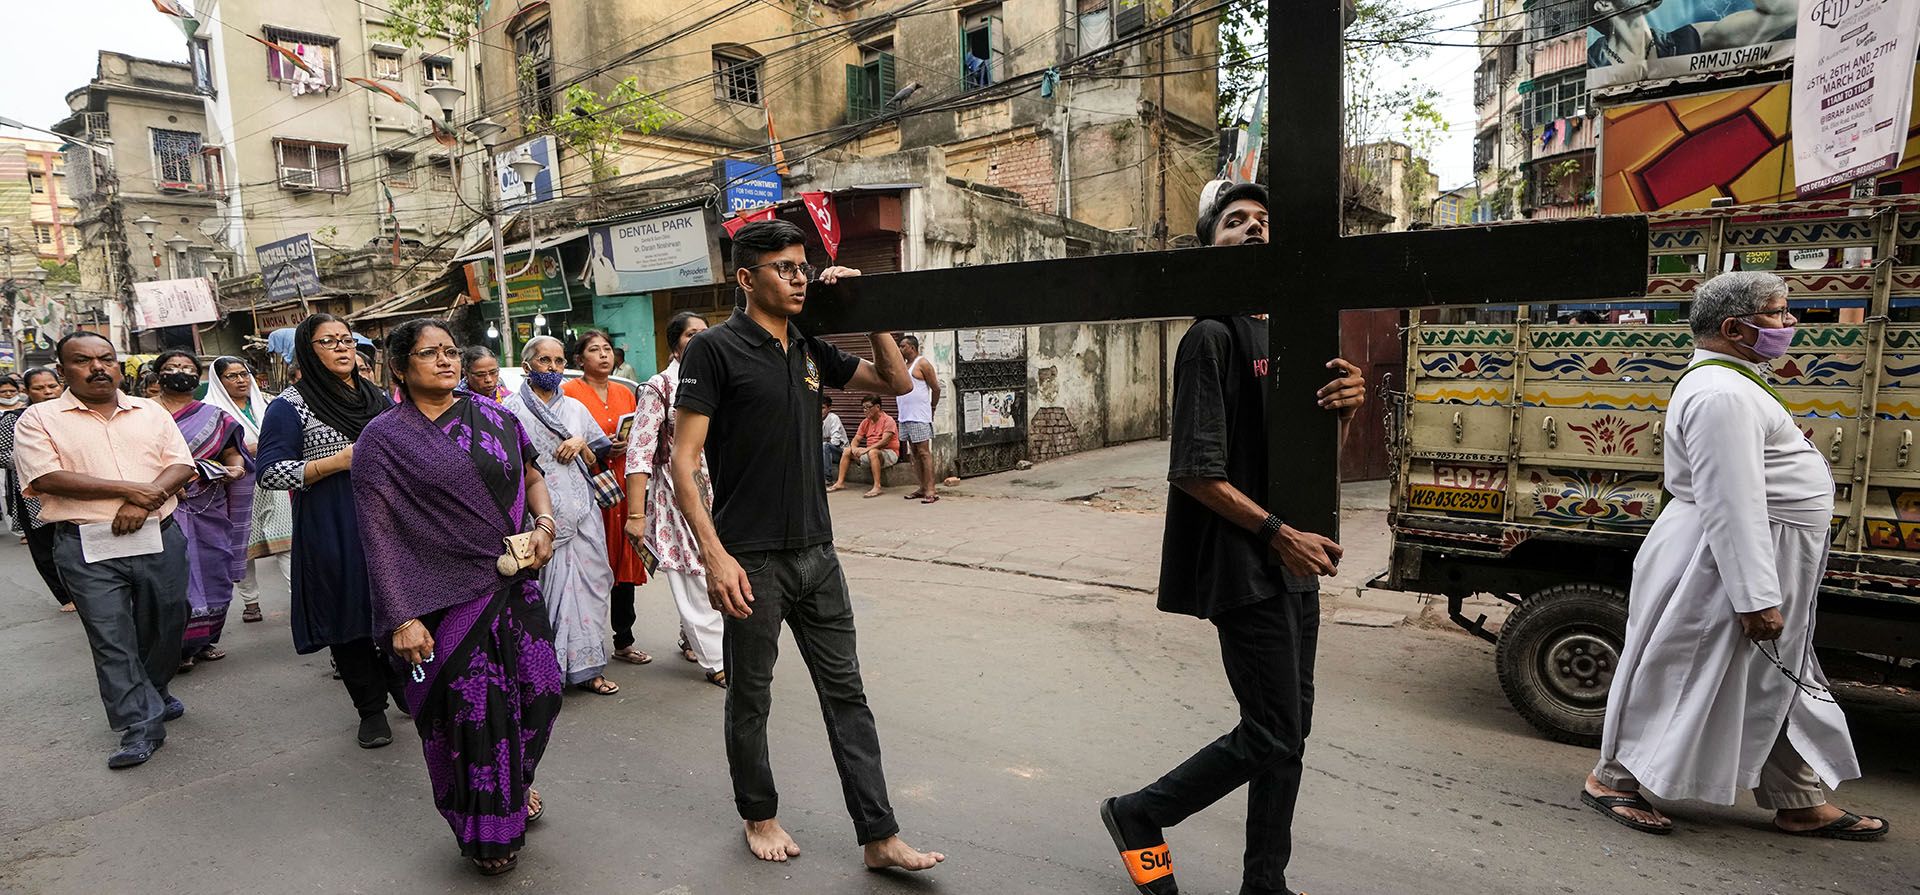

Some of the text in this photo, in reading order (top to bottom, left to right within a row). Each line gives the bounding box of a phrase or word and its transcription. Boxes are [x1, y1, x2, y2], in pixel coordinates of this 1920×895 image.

[1733, 45, 1773, 64] SHAW
[1830, 61, 1850, 80] 26TH
[1853, 52, 1871, 69] AND
[1873, 38, 1897, 60] 27TH
[1823, 62, 1875, 95] MARCH 2022
[1844, 89, 1852, 99] TO
[1846, 94, 1874, 115] BANQUET
[1811, 176, 1832, 190] DETAILS
[619, 217, 693, 239] DENTAL PARK
[286, 239, 310, 260] GLASS
[263, 314, 287, 328] ANOKHA
